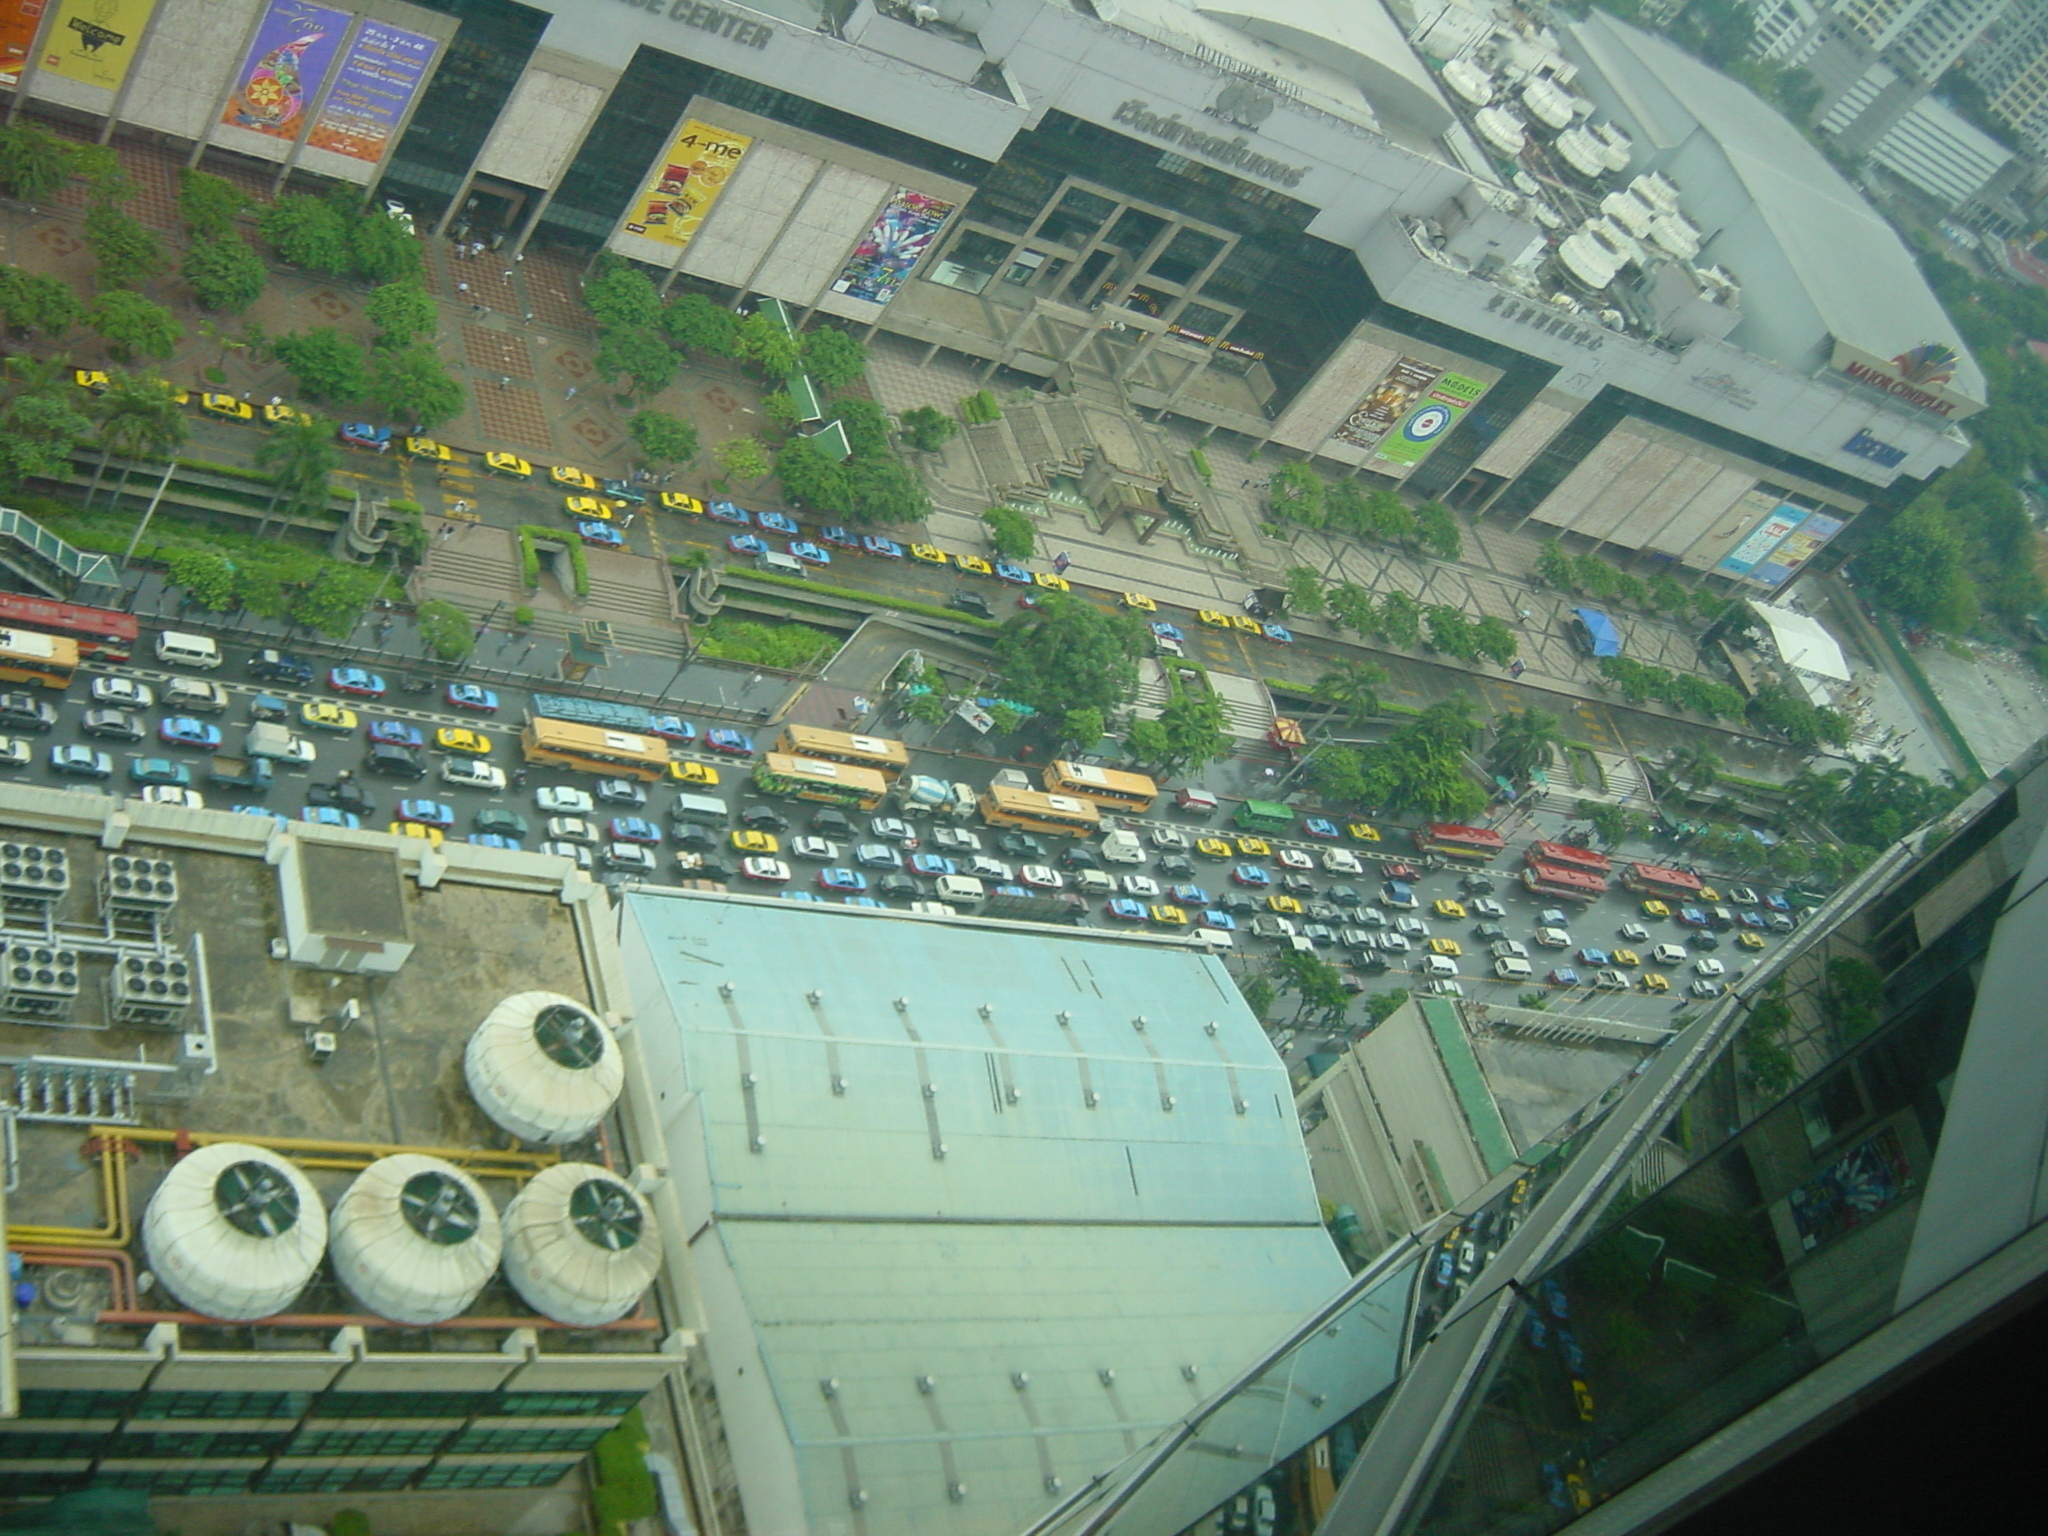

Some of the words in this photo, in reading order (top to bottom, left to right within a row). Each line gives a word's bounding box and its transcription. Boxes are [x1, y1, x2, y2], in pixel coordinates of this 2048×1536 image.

[71, 19, 121, 44] Welcome
[669, 0, 773, 50] CENTER
[681, 134, 742, 159] 4-me
[1847, 361, 1894, 389] MAJOR
